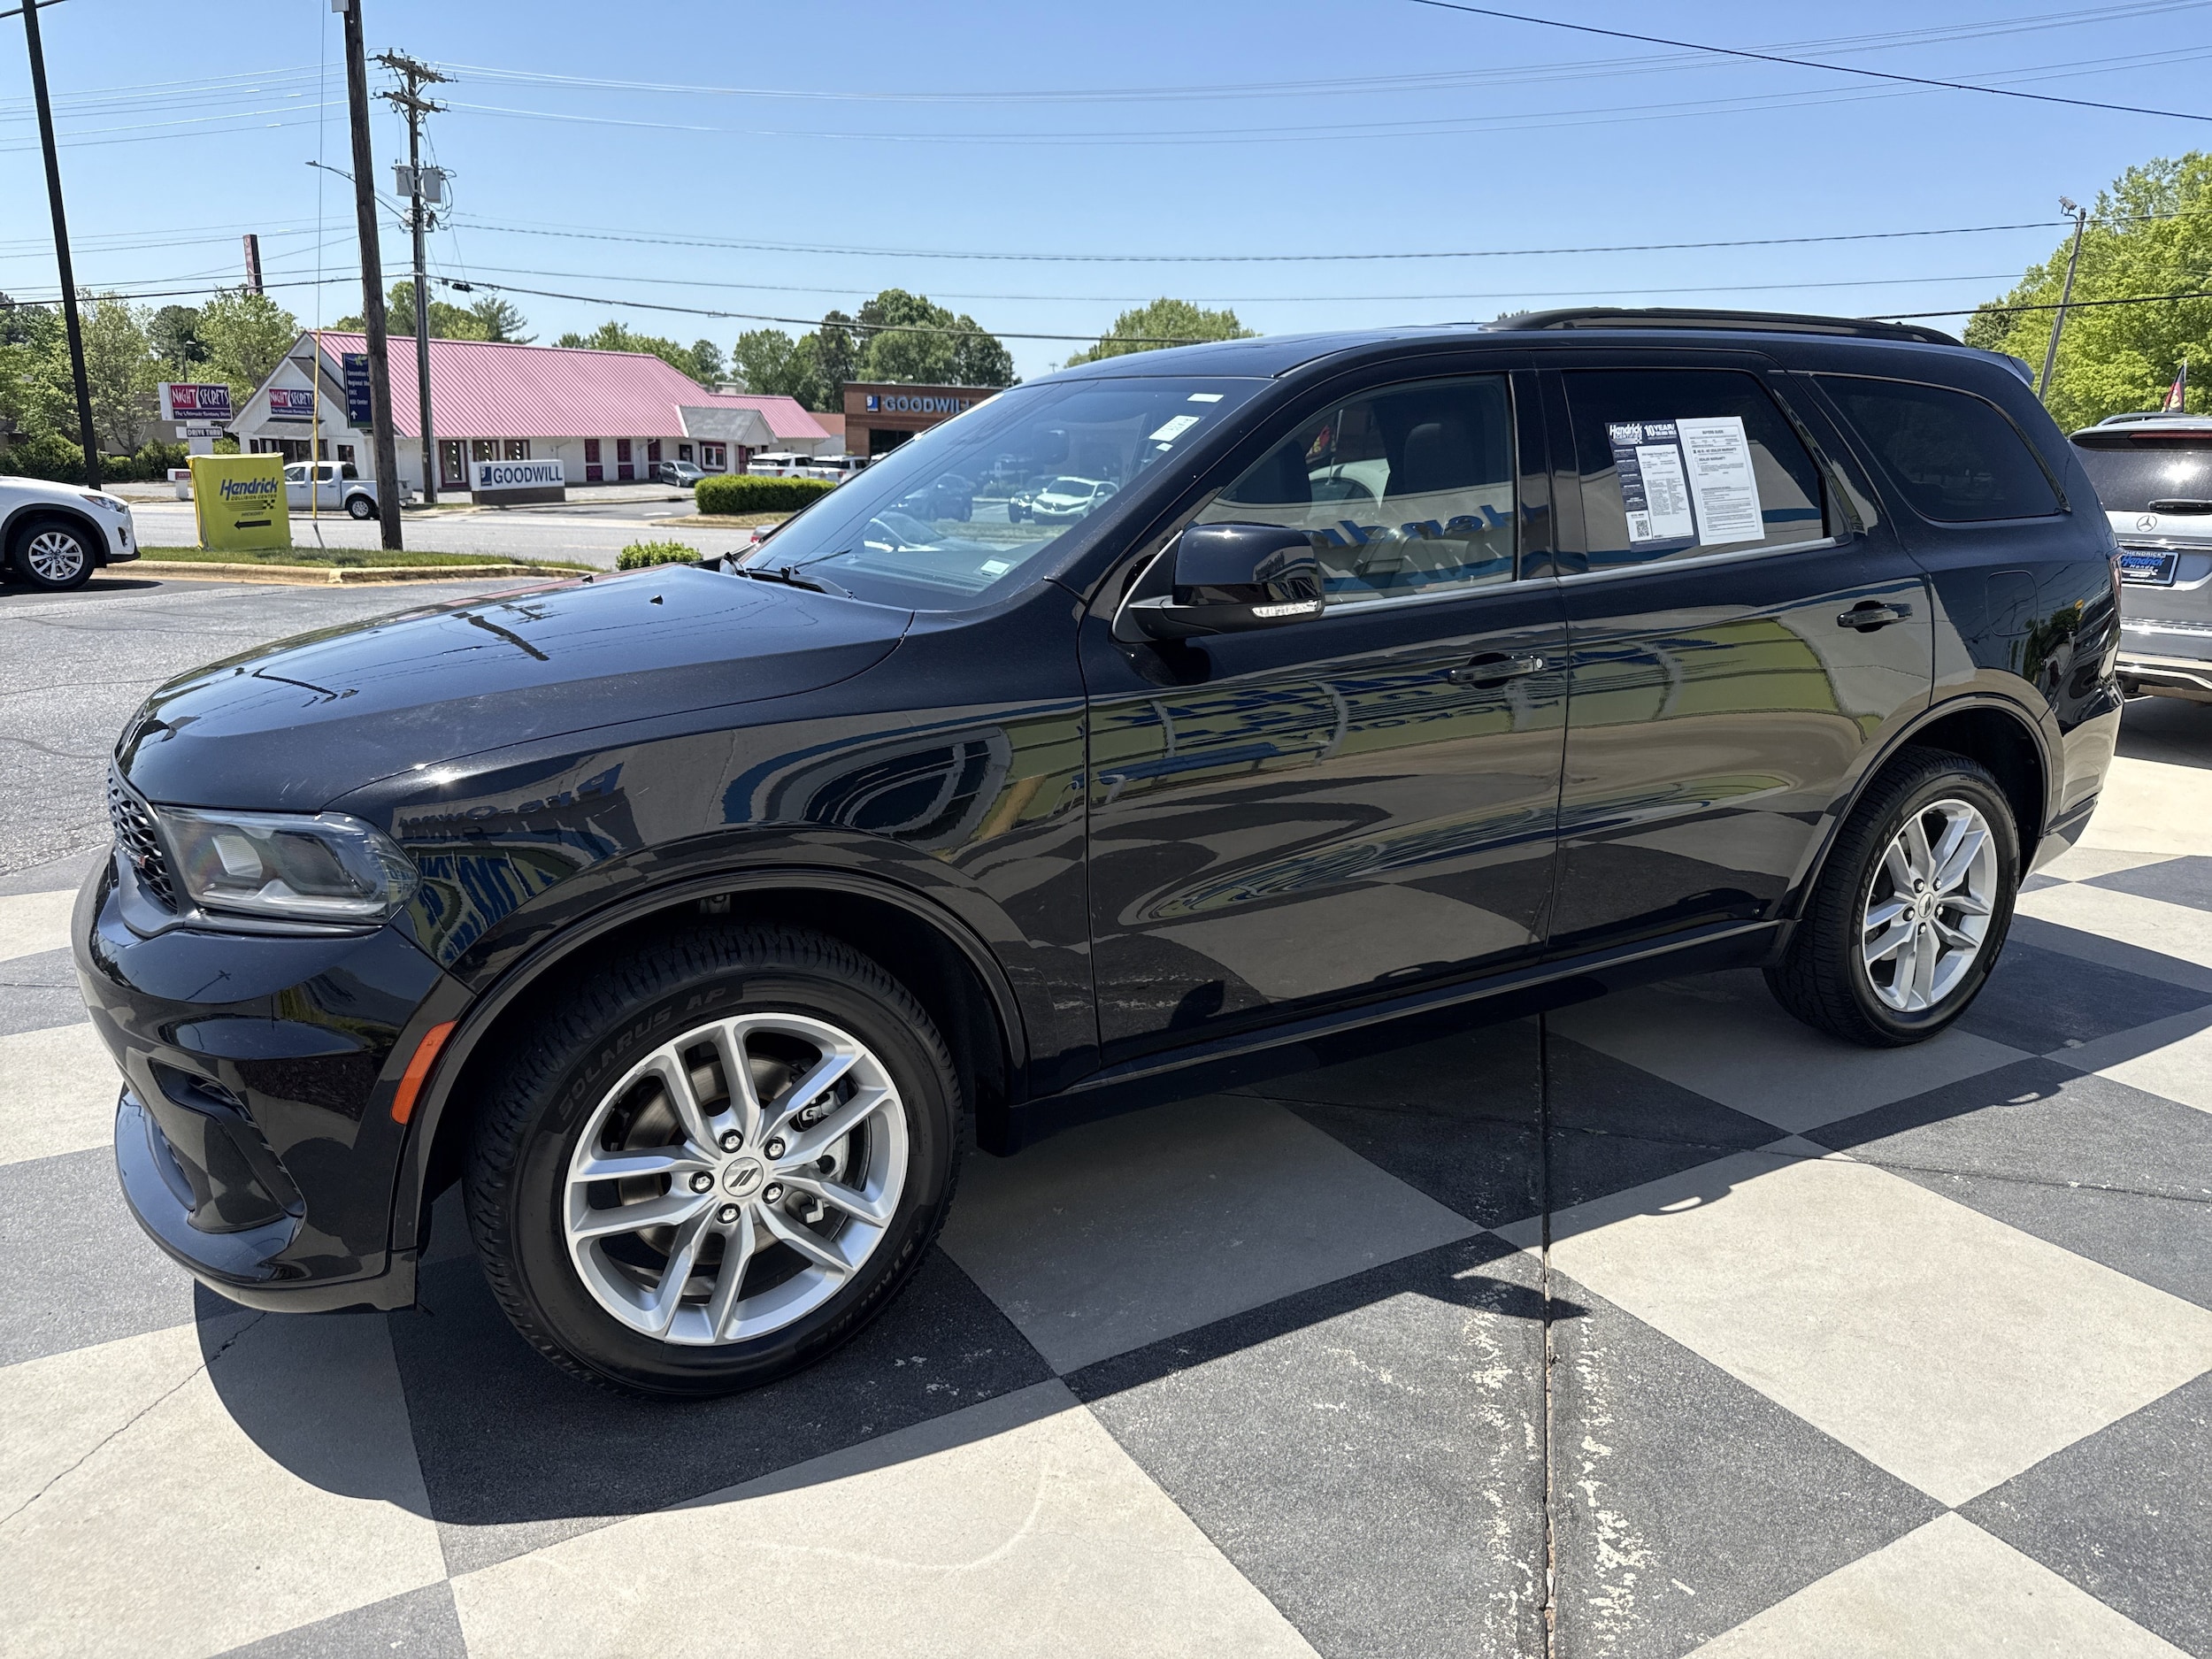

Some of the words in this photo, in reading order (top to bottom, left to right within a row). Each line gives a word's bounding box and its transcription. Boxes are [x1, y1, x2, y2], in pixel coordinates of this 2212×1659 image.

[199, 388, 229, 405] SECRETS
[290, 391, 314, 405] SECRETS
[1609, 423, 1643, 440] Hendrick
[1644, 424, 1655, 437] 10
[493, 465, 563, 485] GOODWILL
[219, 477, 279, 501] Hendrick
[2122, 556, 2165, 566] Hendrick
[558, 1005, 672, 1120] SOLARUS
[687, 987, 726, 1010] AP
